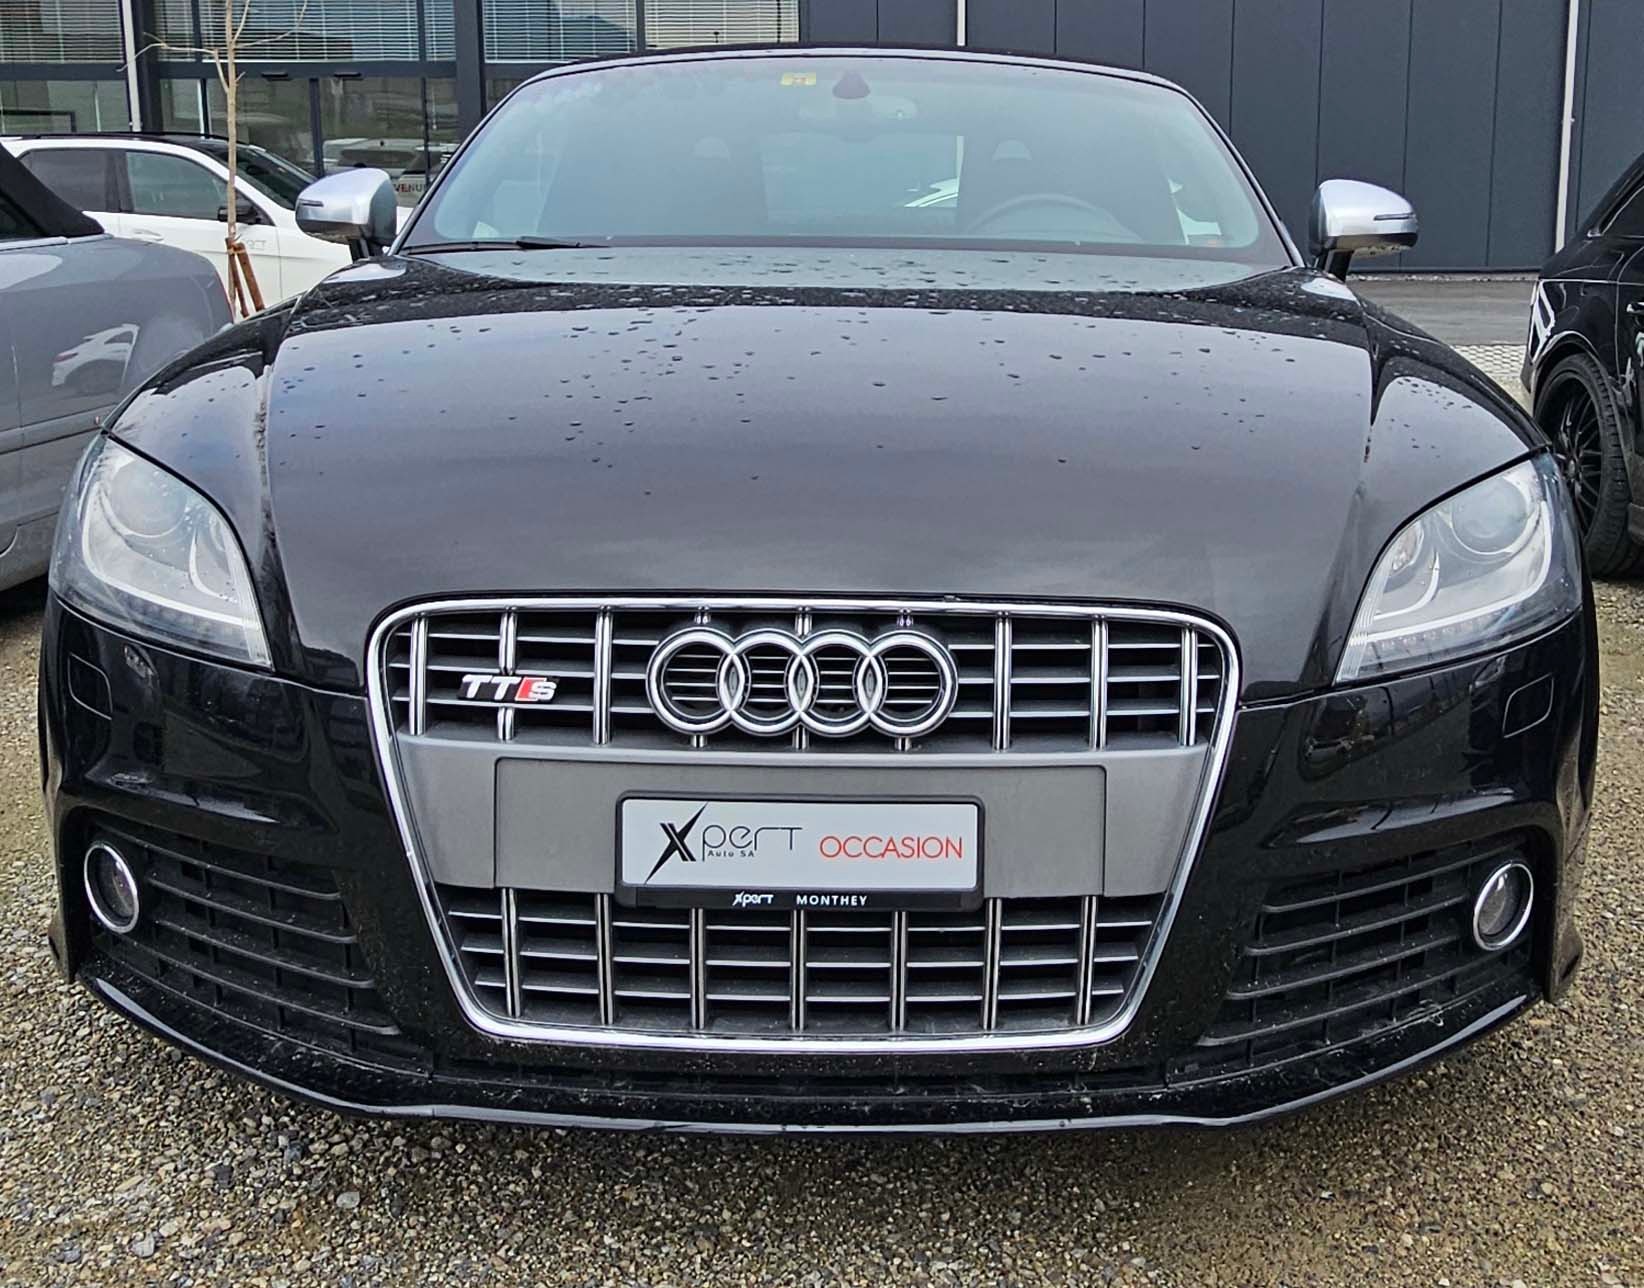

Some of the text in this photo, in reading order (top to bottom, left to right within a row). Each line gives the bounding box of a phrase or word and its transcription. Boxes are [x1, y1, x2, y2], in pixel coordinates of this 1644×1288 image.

[461, 674, 558, 702] TTS
[707, 850, 755, 858] Auto SA
[819, 835, 963, 859] OCCASION
[796, 894, 867, 906] MONTHEY
